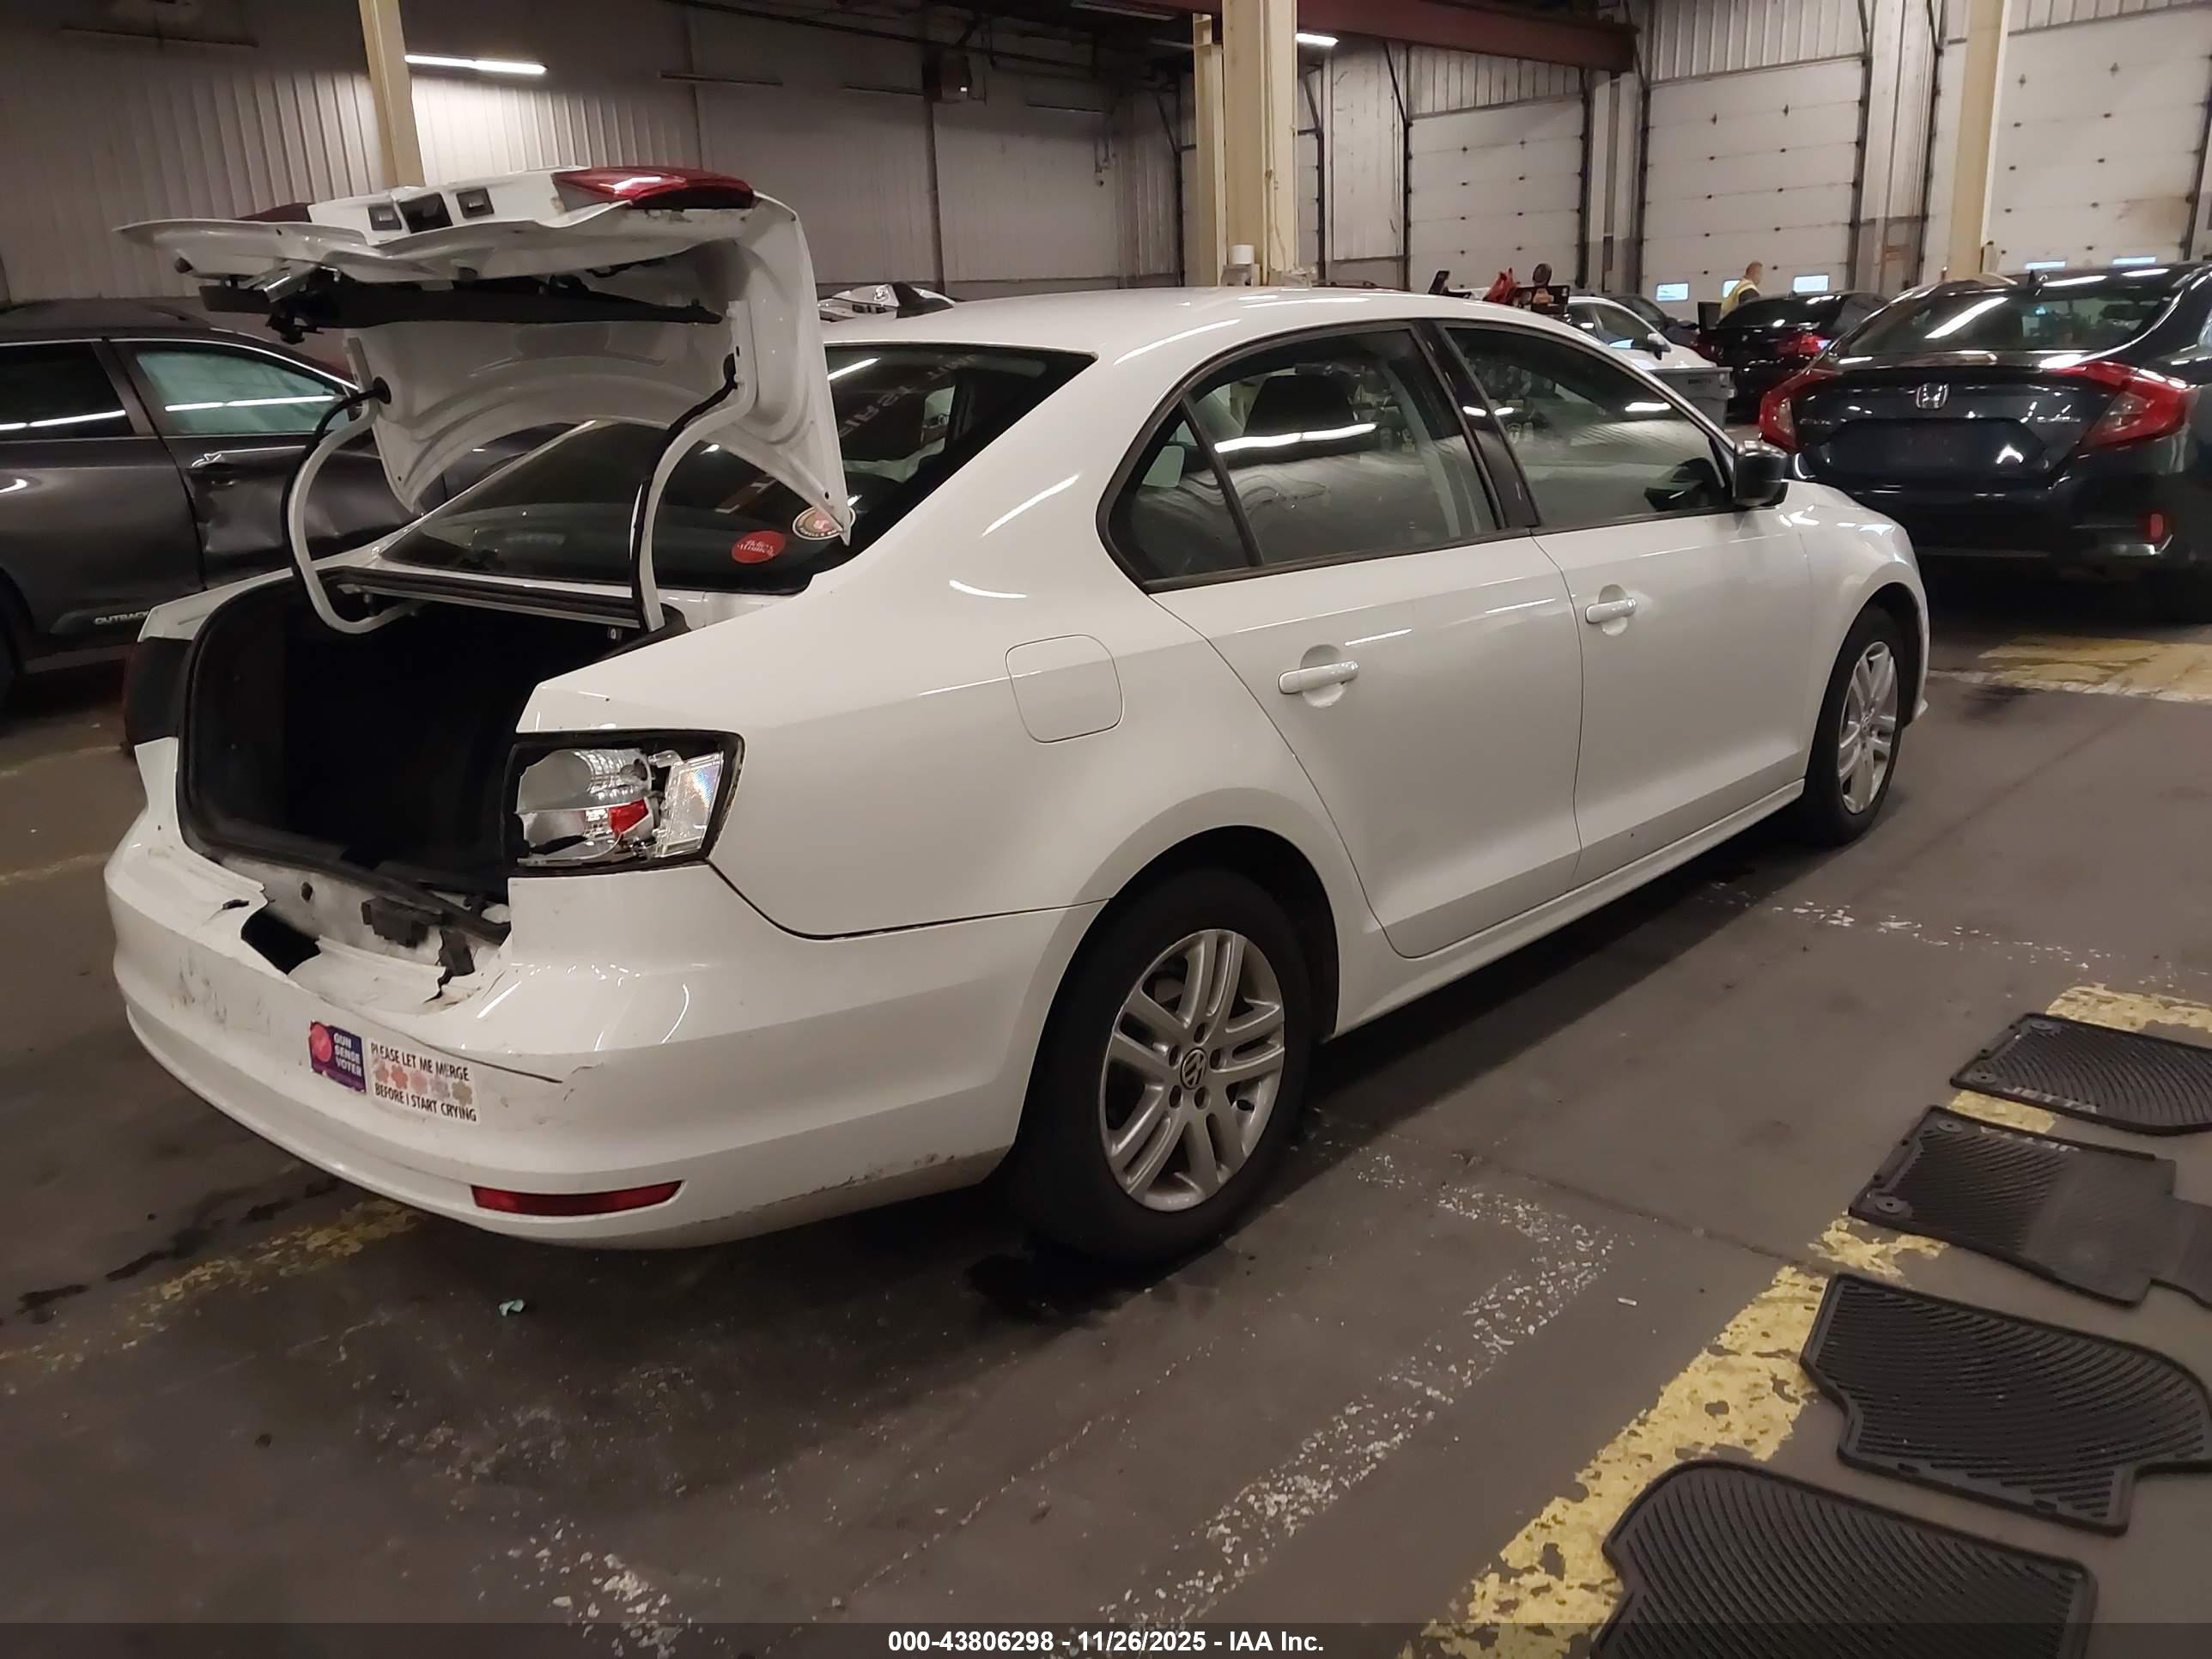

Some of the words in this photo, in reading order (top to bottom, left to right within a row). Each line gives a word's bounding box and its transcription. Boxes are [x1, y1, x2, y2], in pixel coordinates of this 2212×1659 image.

[334, 1033, 351, 1048] GUN
[335, 1045, 361, 1065] SENSE
[371, 1042, 399, 1066] PLEASE
[402, 1053, 416, 1068] LET
[420, 1057, 434, 1073] ME
[436, 1061, 469, 1081] MERGE
[336, 1057, 362, 1077] VOTER
[375, 1083, 404, 1104] BEFORE
[407, 1094, 409, 1106] I
[411, 1095, 438, 1114] START
[441, 1103, 477, 1121] CRYING
